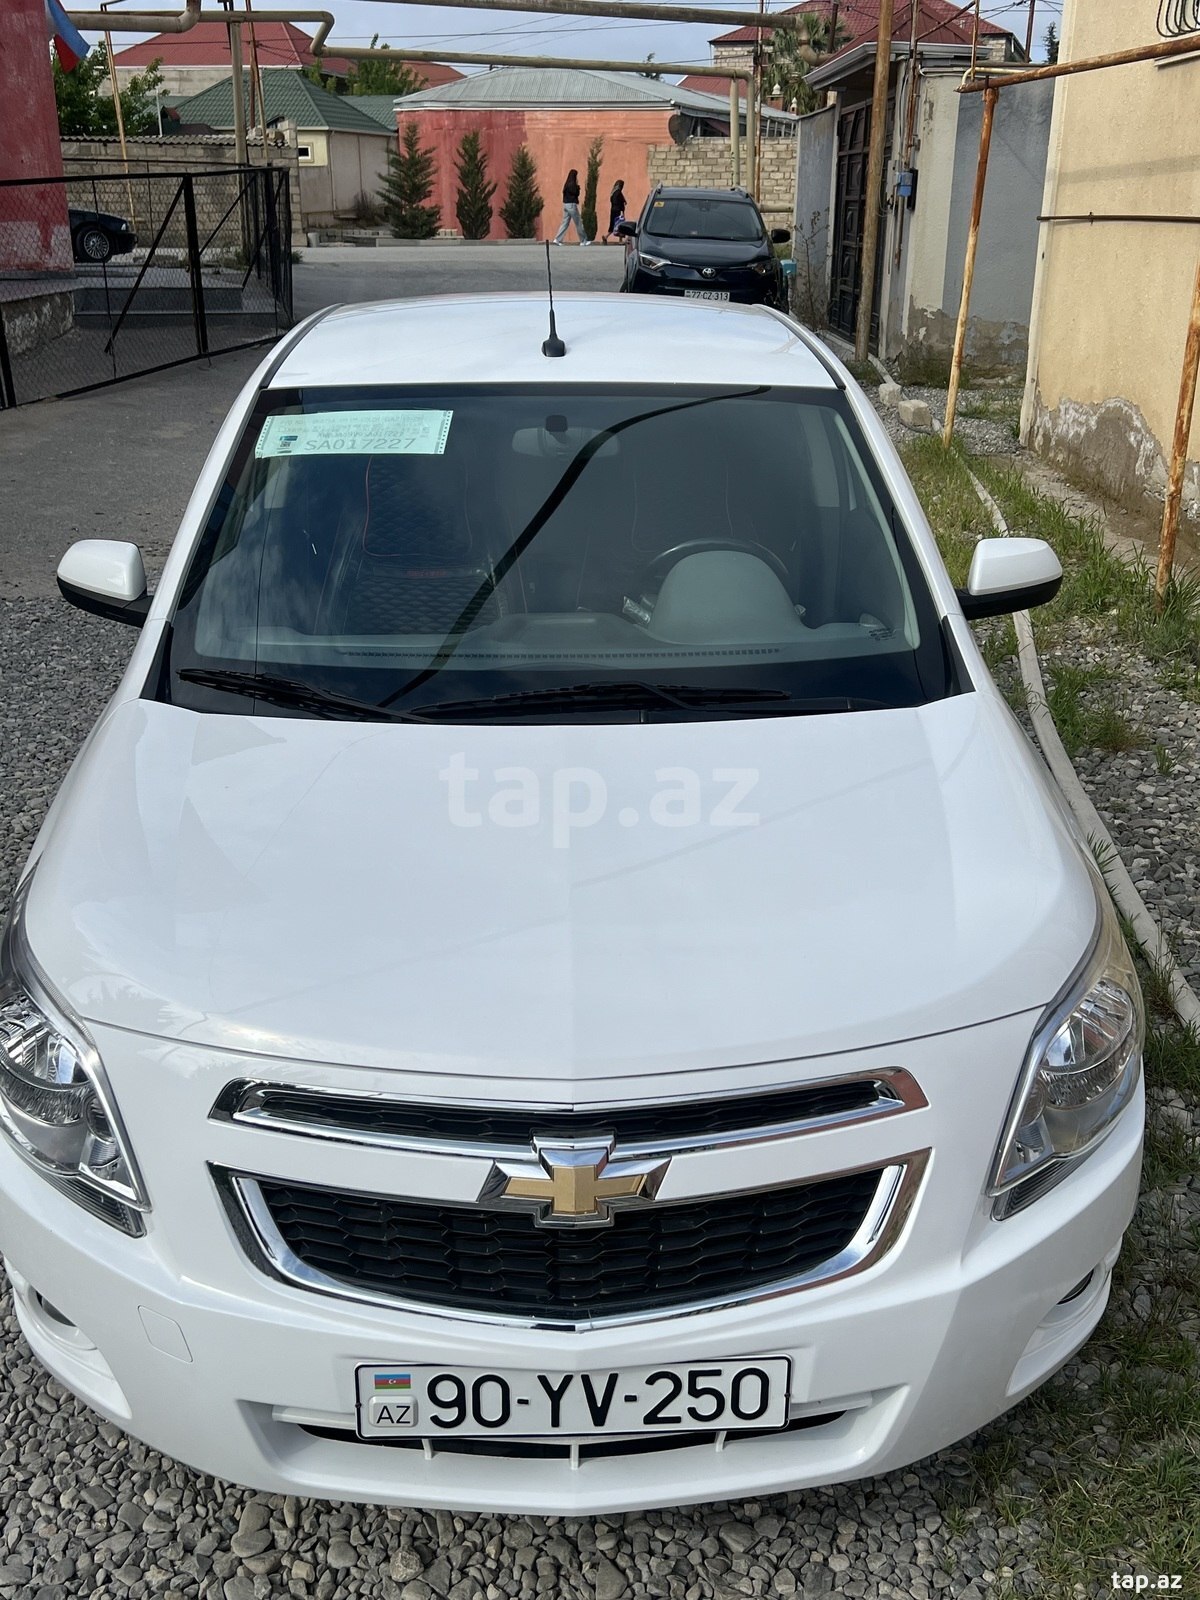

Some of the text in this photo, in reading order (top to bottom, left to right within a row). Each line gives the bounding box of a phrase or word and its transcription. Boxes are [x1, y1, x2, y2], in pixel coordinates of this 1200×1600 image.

[304, 438, 416, 451] SA017227
[426, 1367, 770, 1429] 90-YV-250
[376, 1405, 411, 1424] AZ
